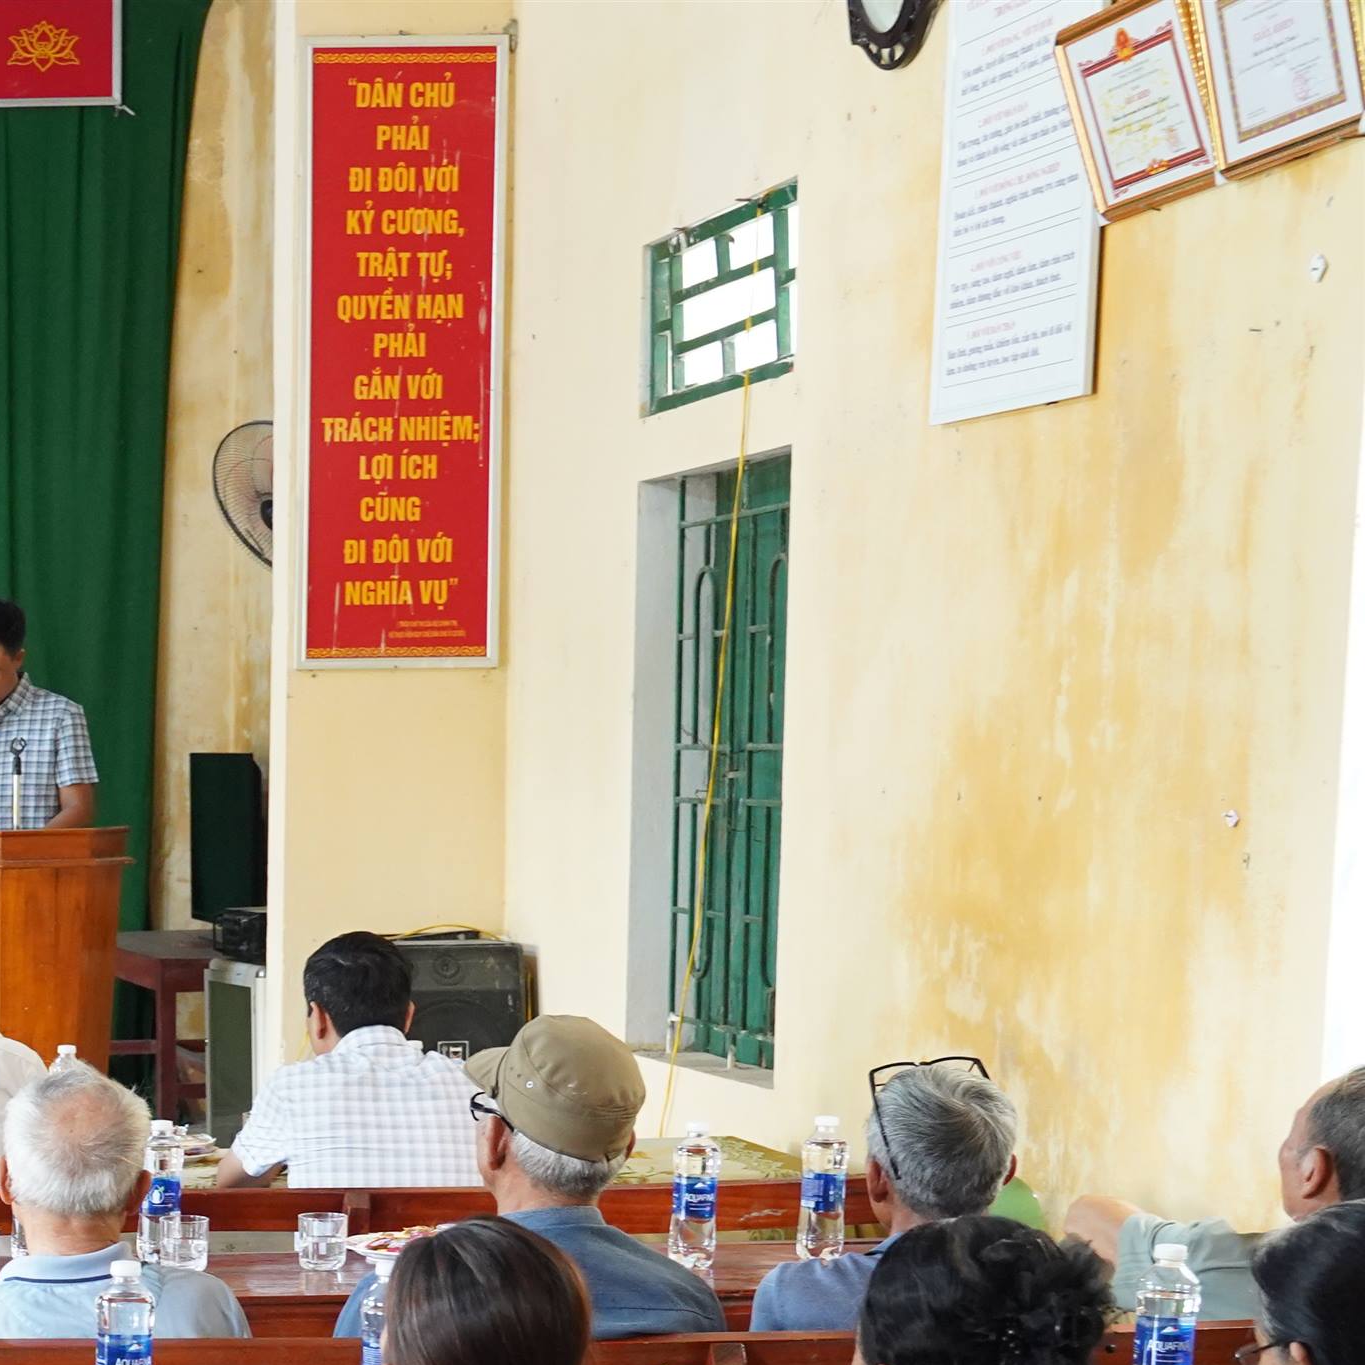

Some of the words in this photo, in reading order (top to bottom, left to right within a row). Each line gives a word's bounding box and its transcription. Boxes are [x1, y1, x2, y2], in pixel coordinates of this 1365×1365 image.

[409, 71, 456, 109] CHỦ
[376, 115, 430, 151] PHẢI
[348, 167, 372, 193] ĐI
[377, 161, 416, 193] ĐÔI
[422, 159, 459, 193] VỚI
[346, 200, 376, 235] KỶ
[381, 208, 465, 238] CƯƠNG,
[356, 246, 411, 282] TRẬT
[417, 249, 453, 284] TỰ;
[336, 287, 411, 324] QUYỀN
[416, 293, 464, 325] HẠN
[373, 322, 427, 358] PHẢI
[354, 366, 400, 400] GẮN
[406, 367, 444, 400] VỚI
[321, 411, 394, 443] TRÁCH
[399, 409, 481, 447] NHIỆM;
[358, 453, 394, 485] LỢI
[400, 448, 438, 480] ÍCH
[359, 491, 421, 522] CŨNG
[343, 538, 367, 564] ĐI
[372, 533, 410, 564] ĐÔI
[416, 531, 453, 564] VỚI
[344, 575, 413, 606] NGHĨA
